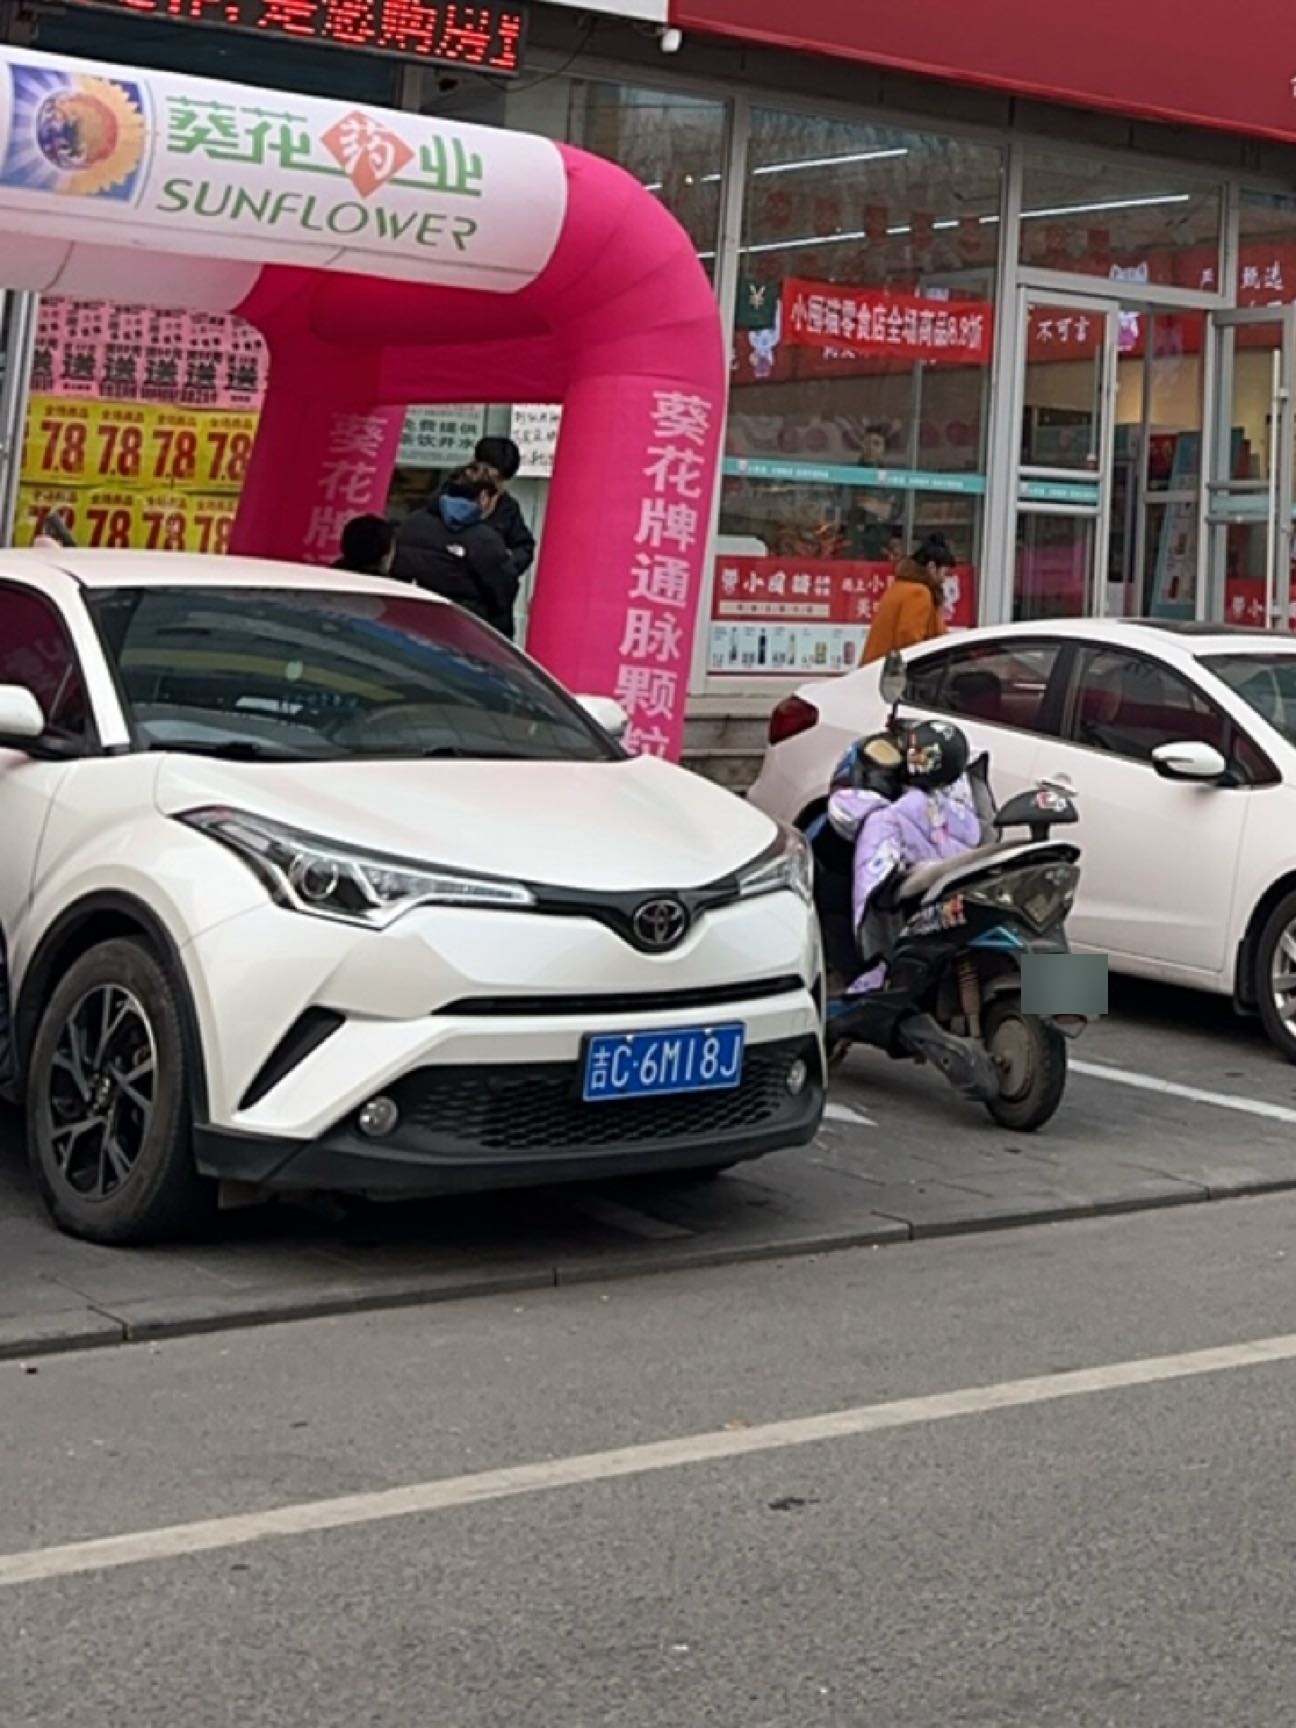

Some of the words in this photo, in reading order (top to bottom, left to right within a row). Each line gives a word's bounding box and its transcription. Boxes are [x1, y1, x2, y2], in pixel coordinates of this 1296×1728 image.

[166, 95, 482, 198] 葵花药业
[157, 177, 477, 252] SUNFLOWER
